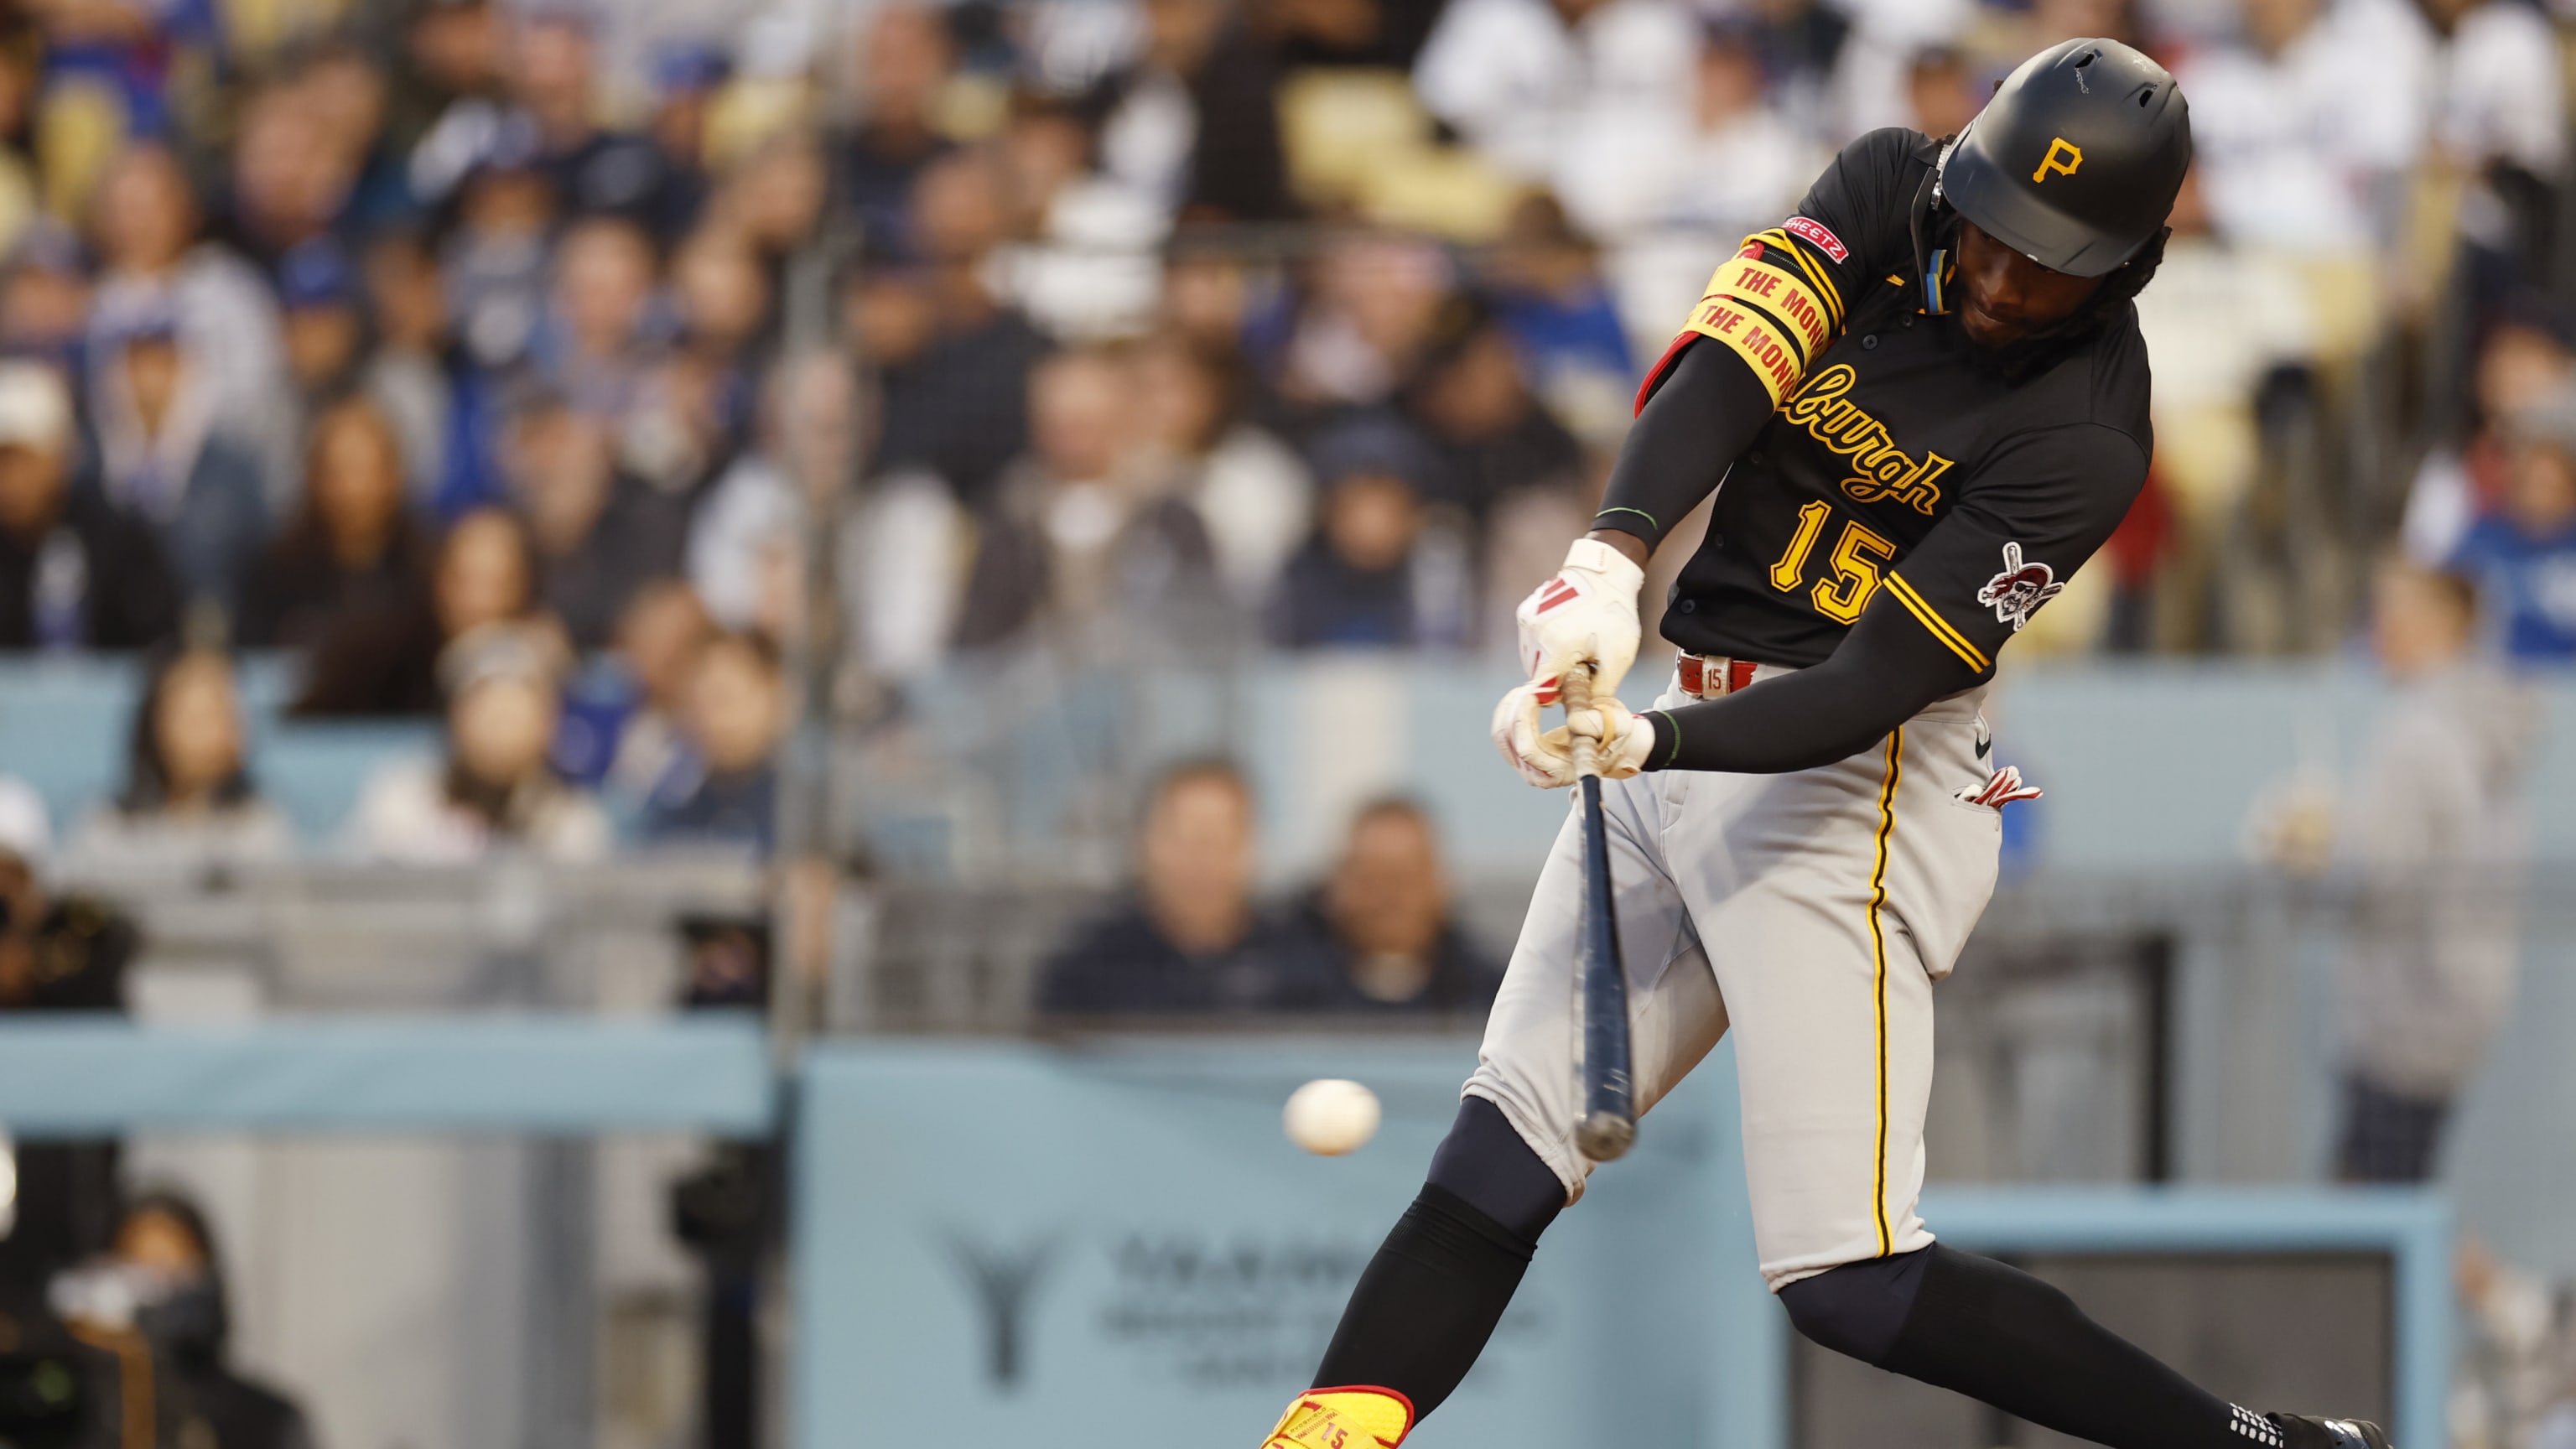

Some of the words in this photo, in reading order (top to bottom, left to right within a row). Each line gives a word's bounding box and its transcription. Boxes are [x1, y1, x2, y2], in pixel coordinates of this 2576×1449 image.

[2033, 137, 2083, 183] P
[1782, 219, 1842, 257] SHEETZ
[1735, 267, 1782, 299] THE
[1698, 305, 1744, 335] THE
[1770, 500, 1897, 625] 15
[1708, 668, 1722, 690] 15
[1321, 1421, 1349, 1449] 15
